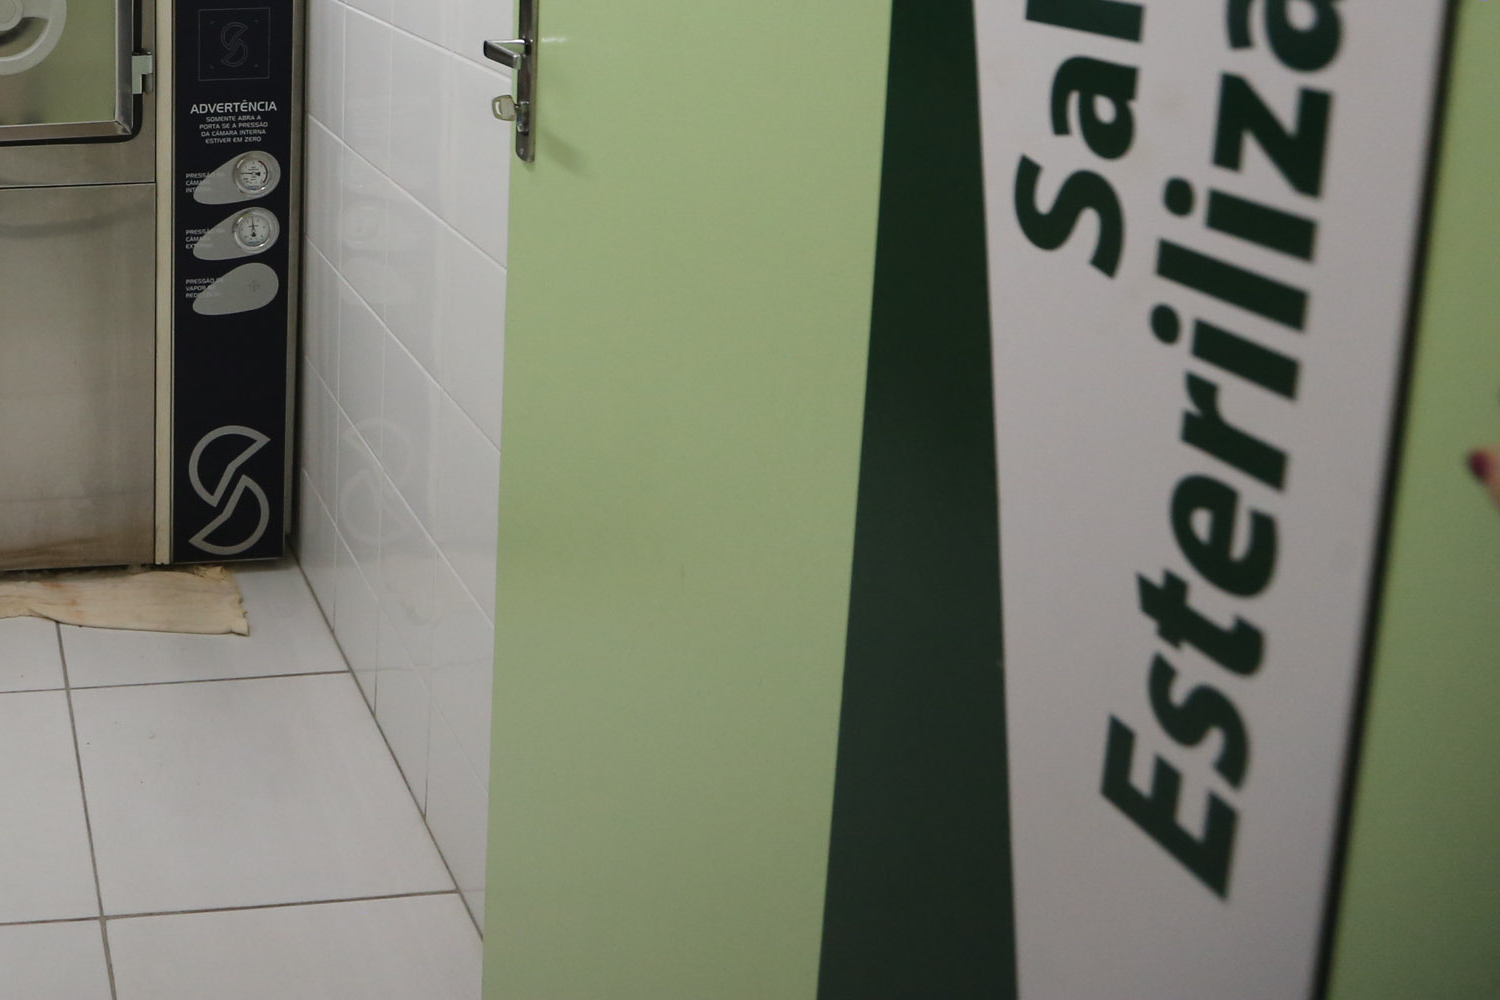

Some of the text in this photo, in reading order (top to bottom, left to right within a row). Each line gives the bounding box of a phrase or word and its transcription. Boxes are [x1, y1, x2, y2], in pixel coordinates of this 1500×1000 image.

[190, 99, 277, 114] ADVERTÊNCIA
[206, 115, 236, 123] SOMENTE
[238, 121, 268, 129] PRESSÃO
[211, 129, 238, 137] CÂMARA
